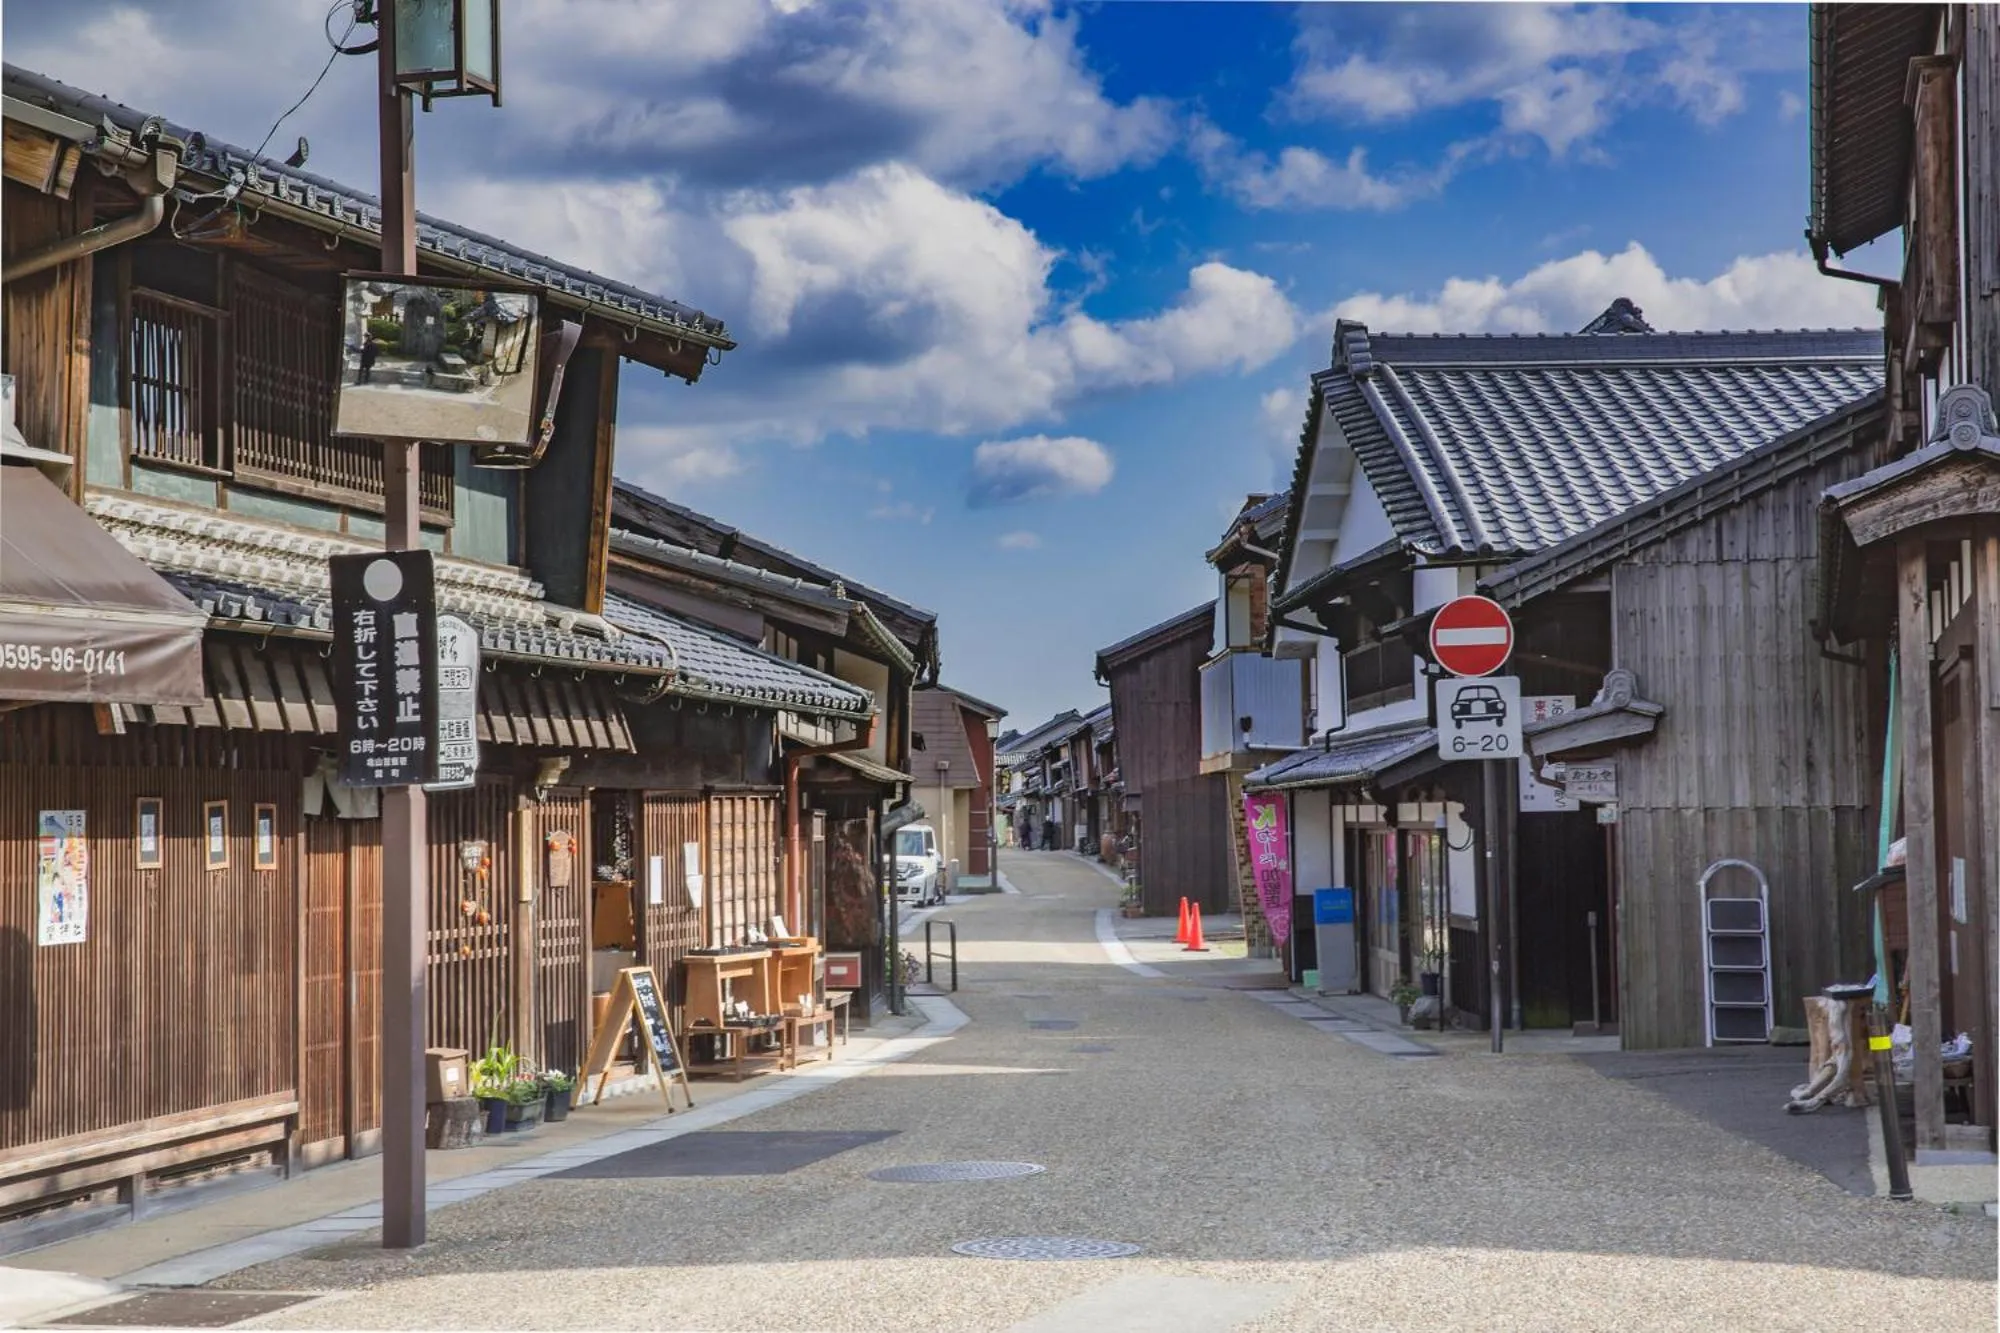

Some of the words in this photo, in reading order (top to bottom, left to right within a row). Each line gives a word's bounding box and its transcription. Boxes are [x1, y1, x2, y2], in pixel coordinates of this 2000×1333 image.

[352, 609, 380, 730] 右折して下さい
[1453, 734, 1509, 753] 6-20
